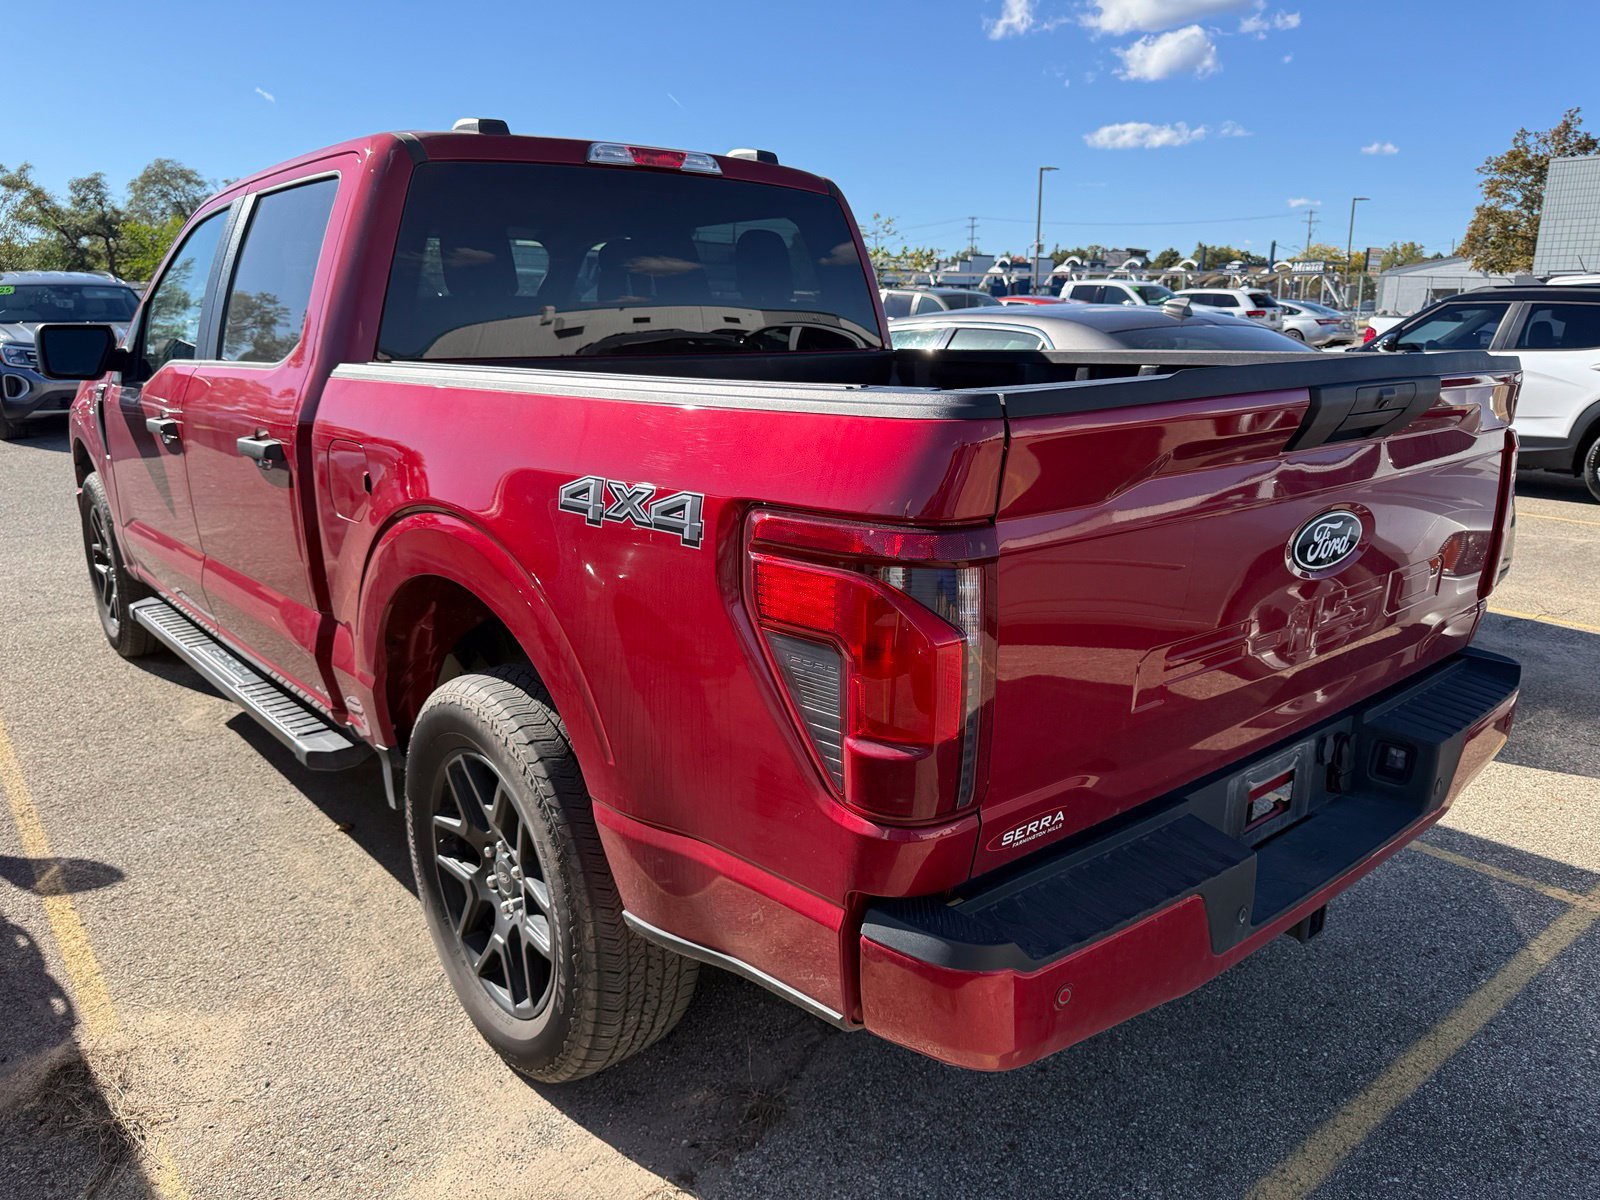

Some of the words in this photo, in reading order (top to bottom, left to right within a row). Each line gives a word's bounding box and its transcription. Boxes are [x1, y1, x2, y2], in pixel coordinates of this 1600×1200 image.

[1306, 520, 1353, 563] Ford
[1001, 811, 1064, 846] SERRA
[1011, 829, 1047, 848] FARMINGTON
